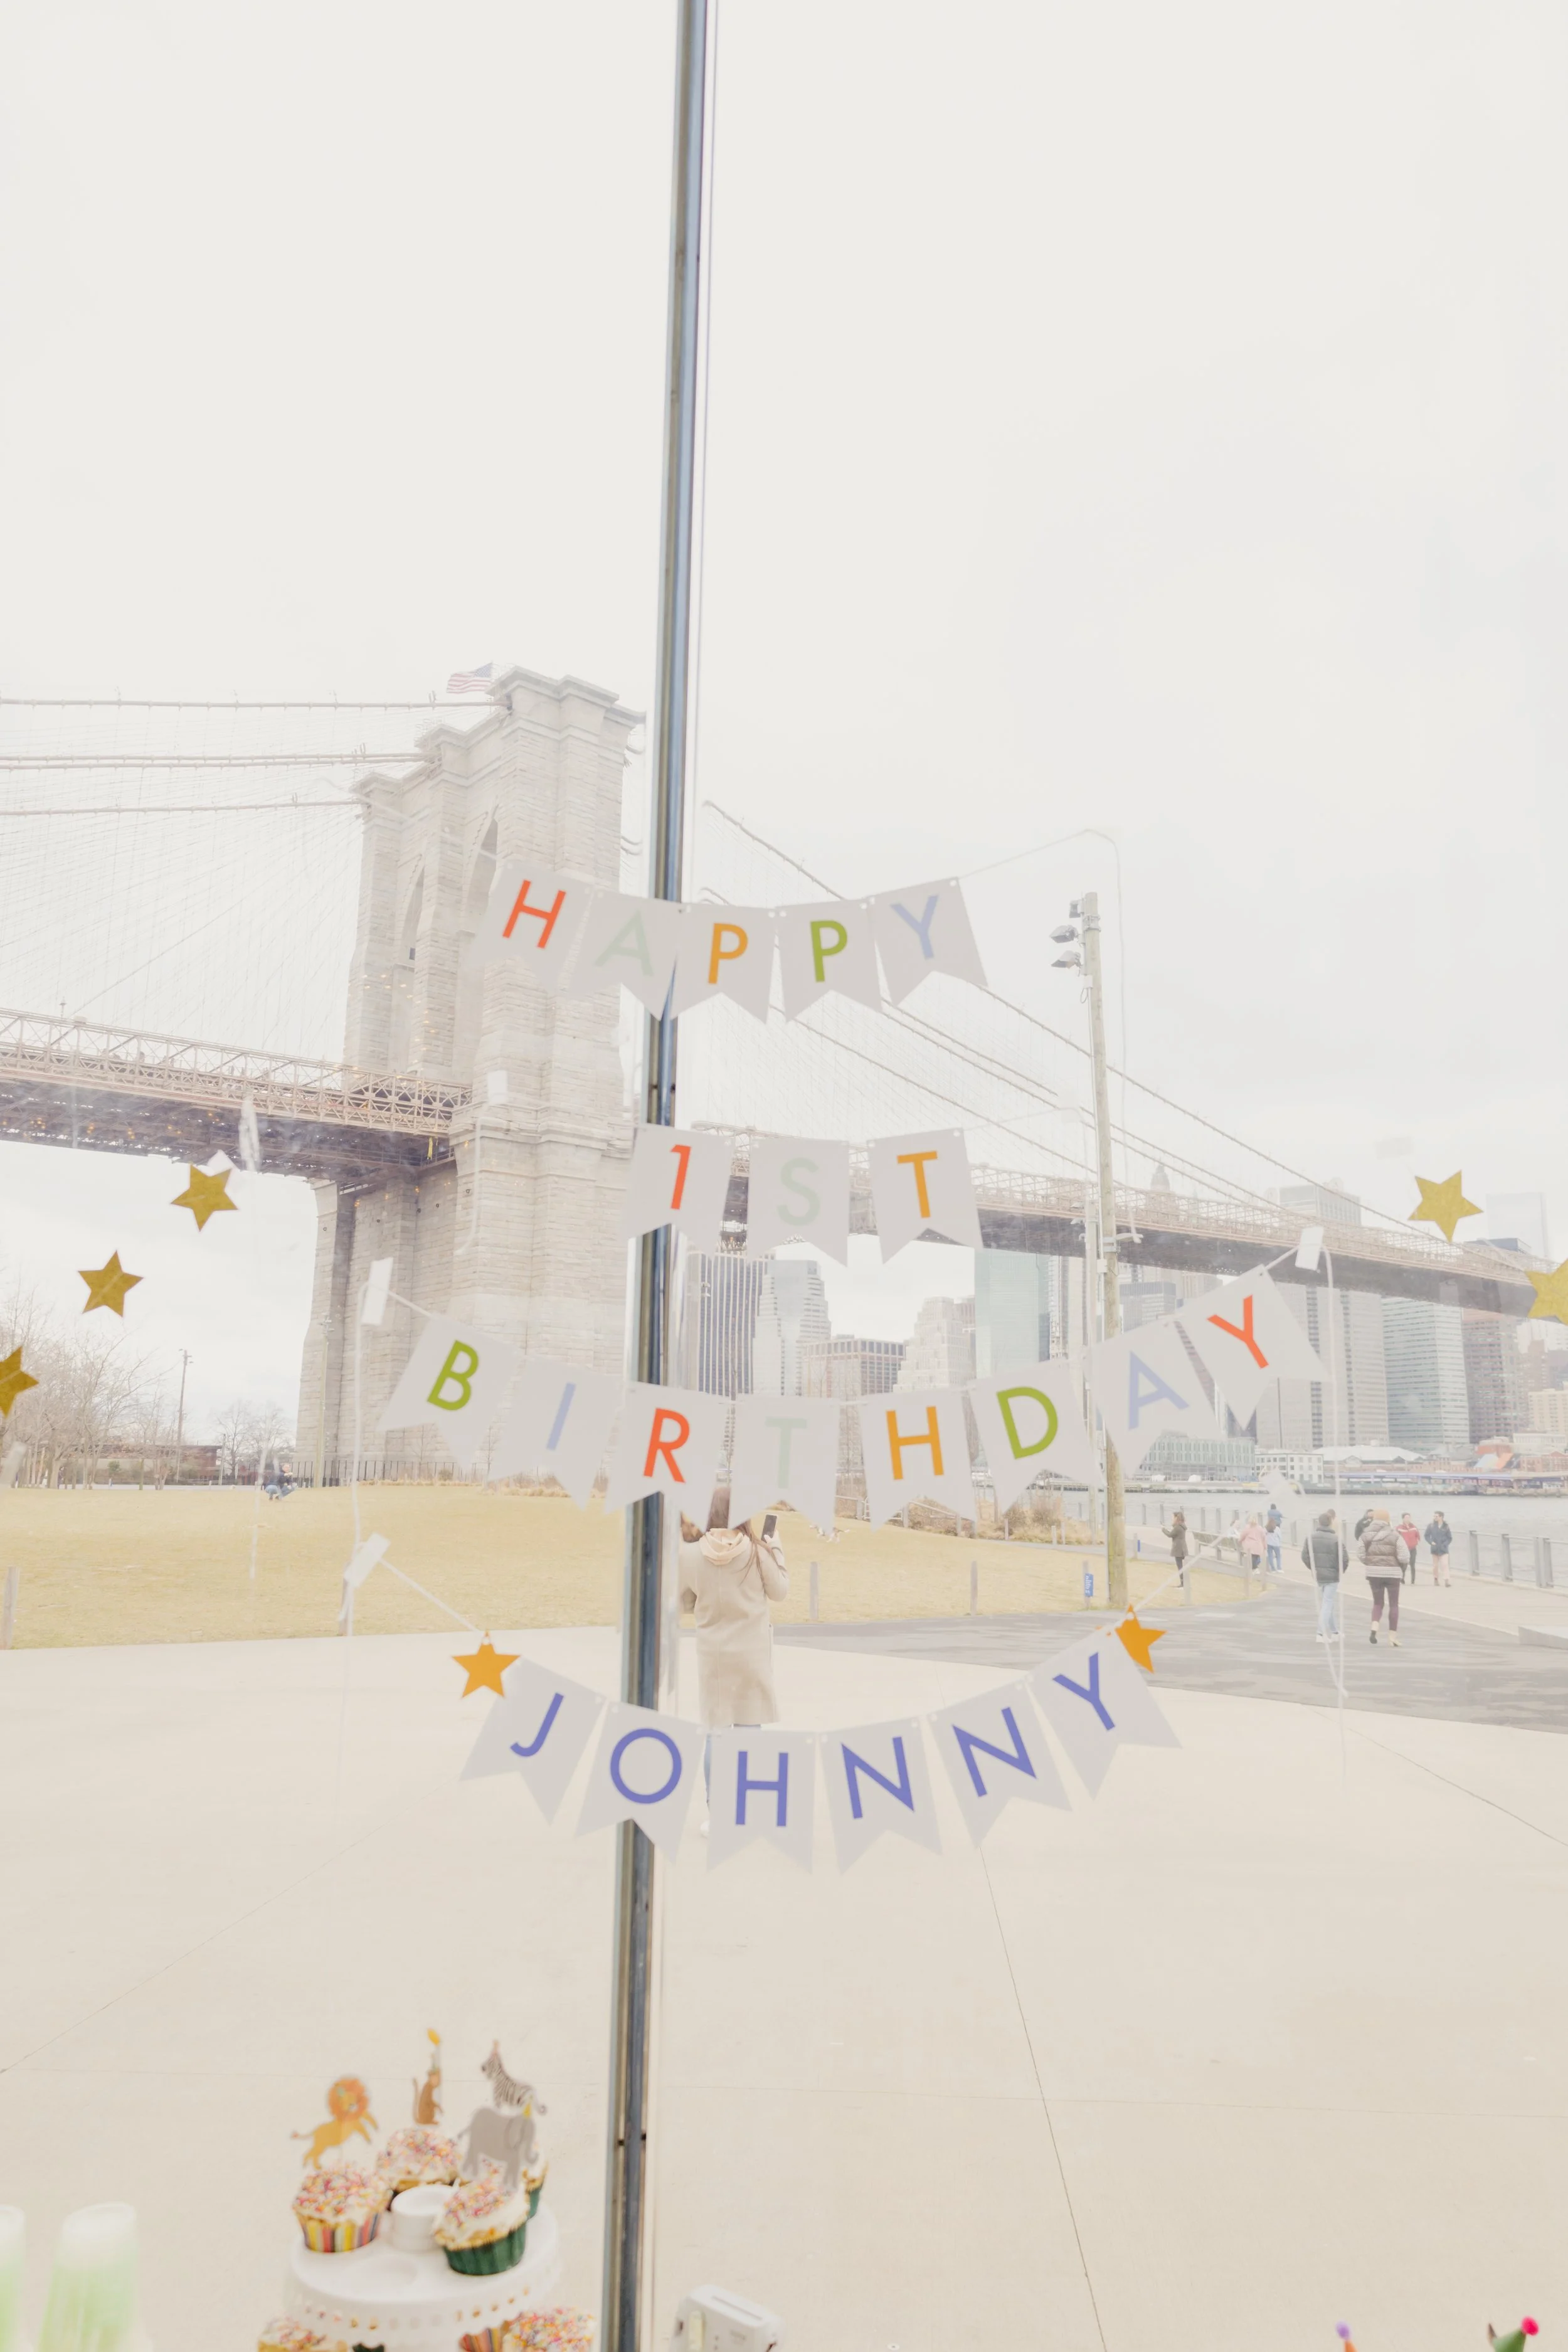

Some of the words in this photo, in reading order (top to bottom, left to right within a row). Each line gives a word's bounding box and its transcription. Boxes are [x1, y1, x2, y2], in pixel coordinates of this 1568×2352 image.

[502, 879, 940, 985] HAPPY
[670, 1144, 938, 1227] 1ST
[426, 1295, 1269, 1488] BIRTHDAY
[510, 1652, 1116, 1826] JOHNNY
